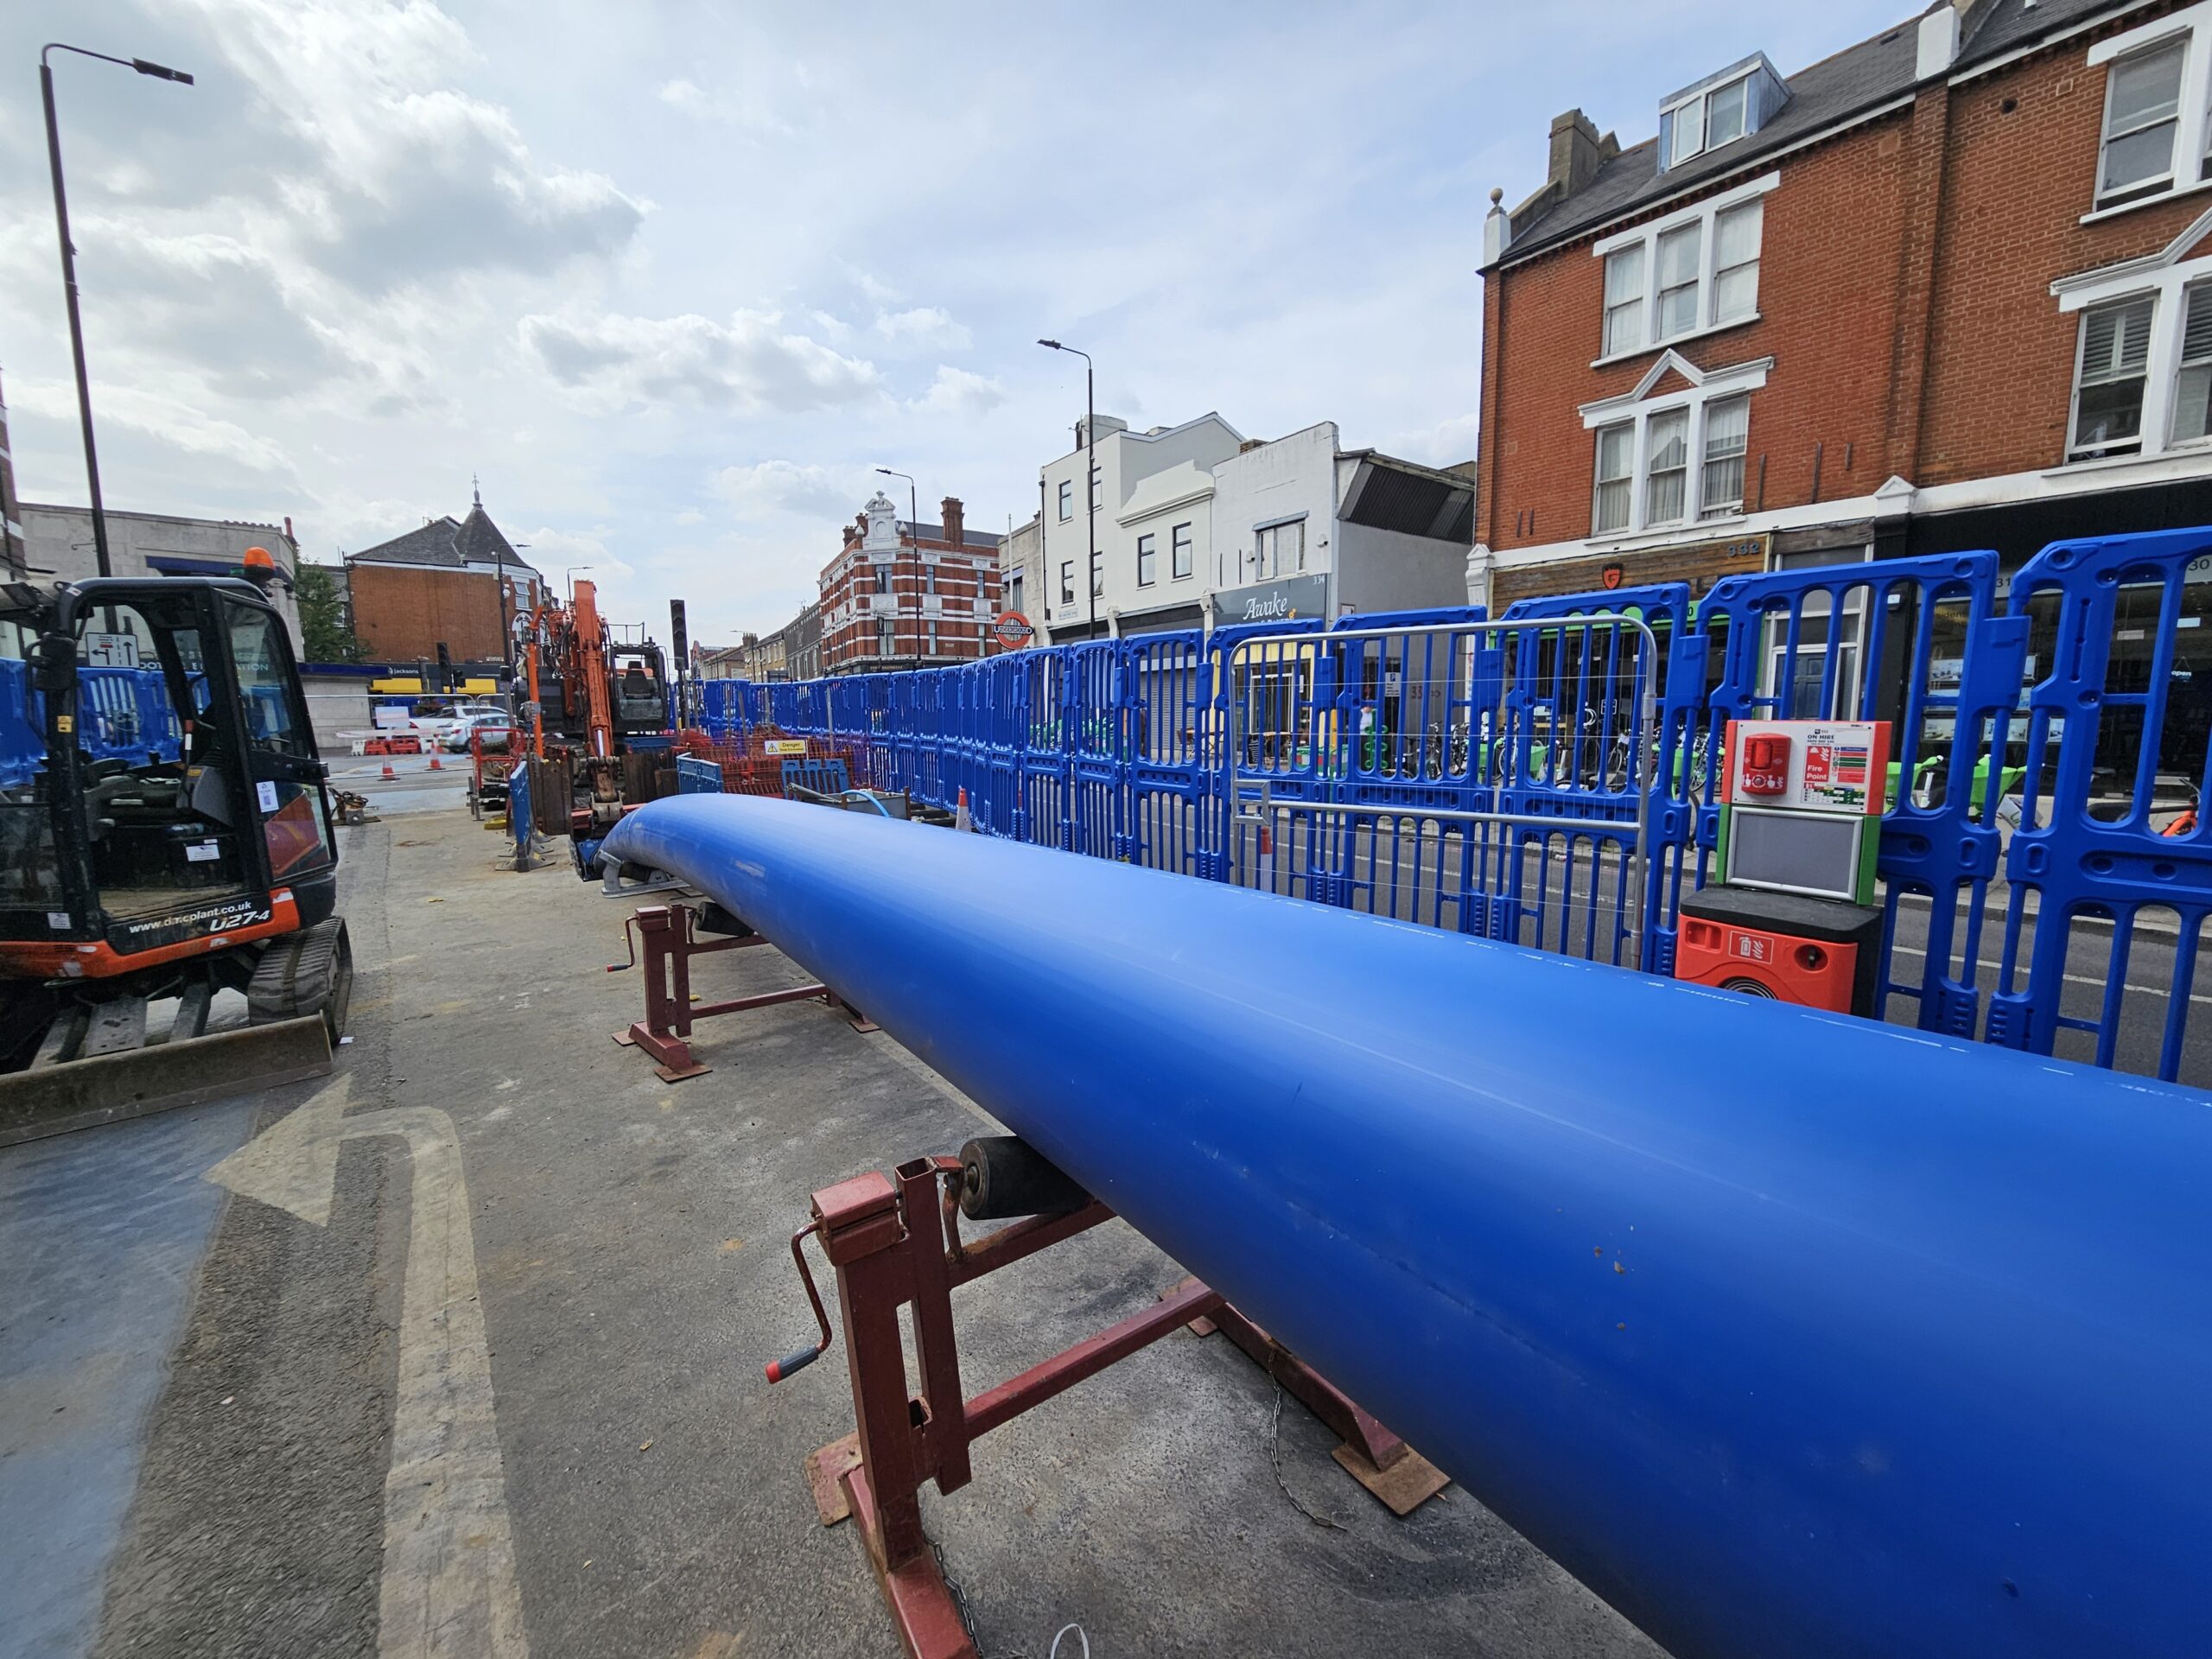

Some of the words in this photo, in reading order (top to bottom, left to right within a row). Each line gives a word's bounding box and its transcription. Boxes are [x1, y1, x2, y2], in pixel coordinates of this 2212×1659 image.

[1728, 542, 1760, 556] 332
[2188, 559, 2209, 571] 30
[1313, 575, 1325, 586] 334
[1243, 591, 1287, 620] Awake
[209, 910, 270, 932] U27-4
